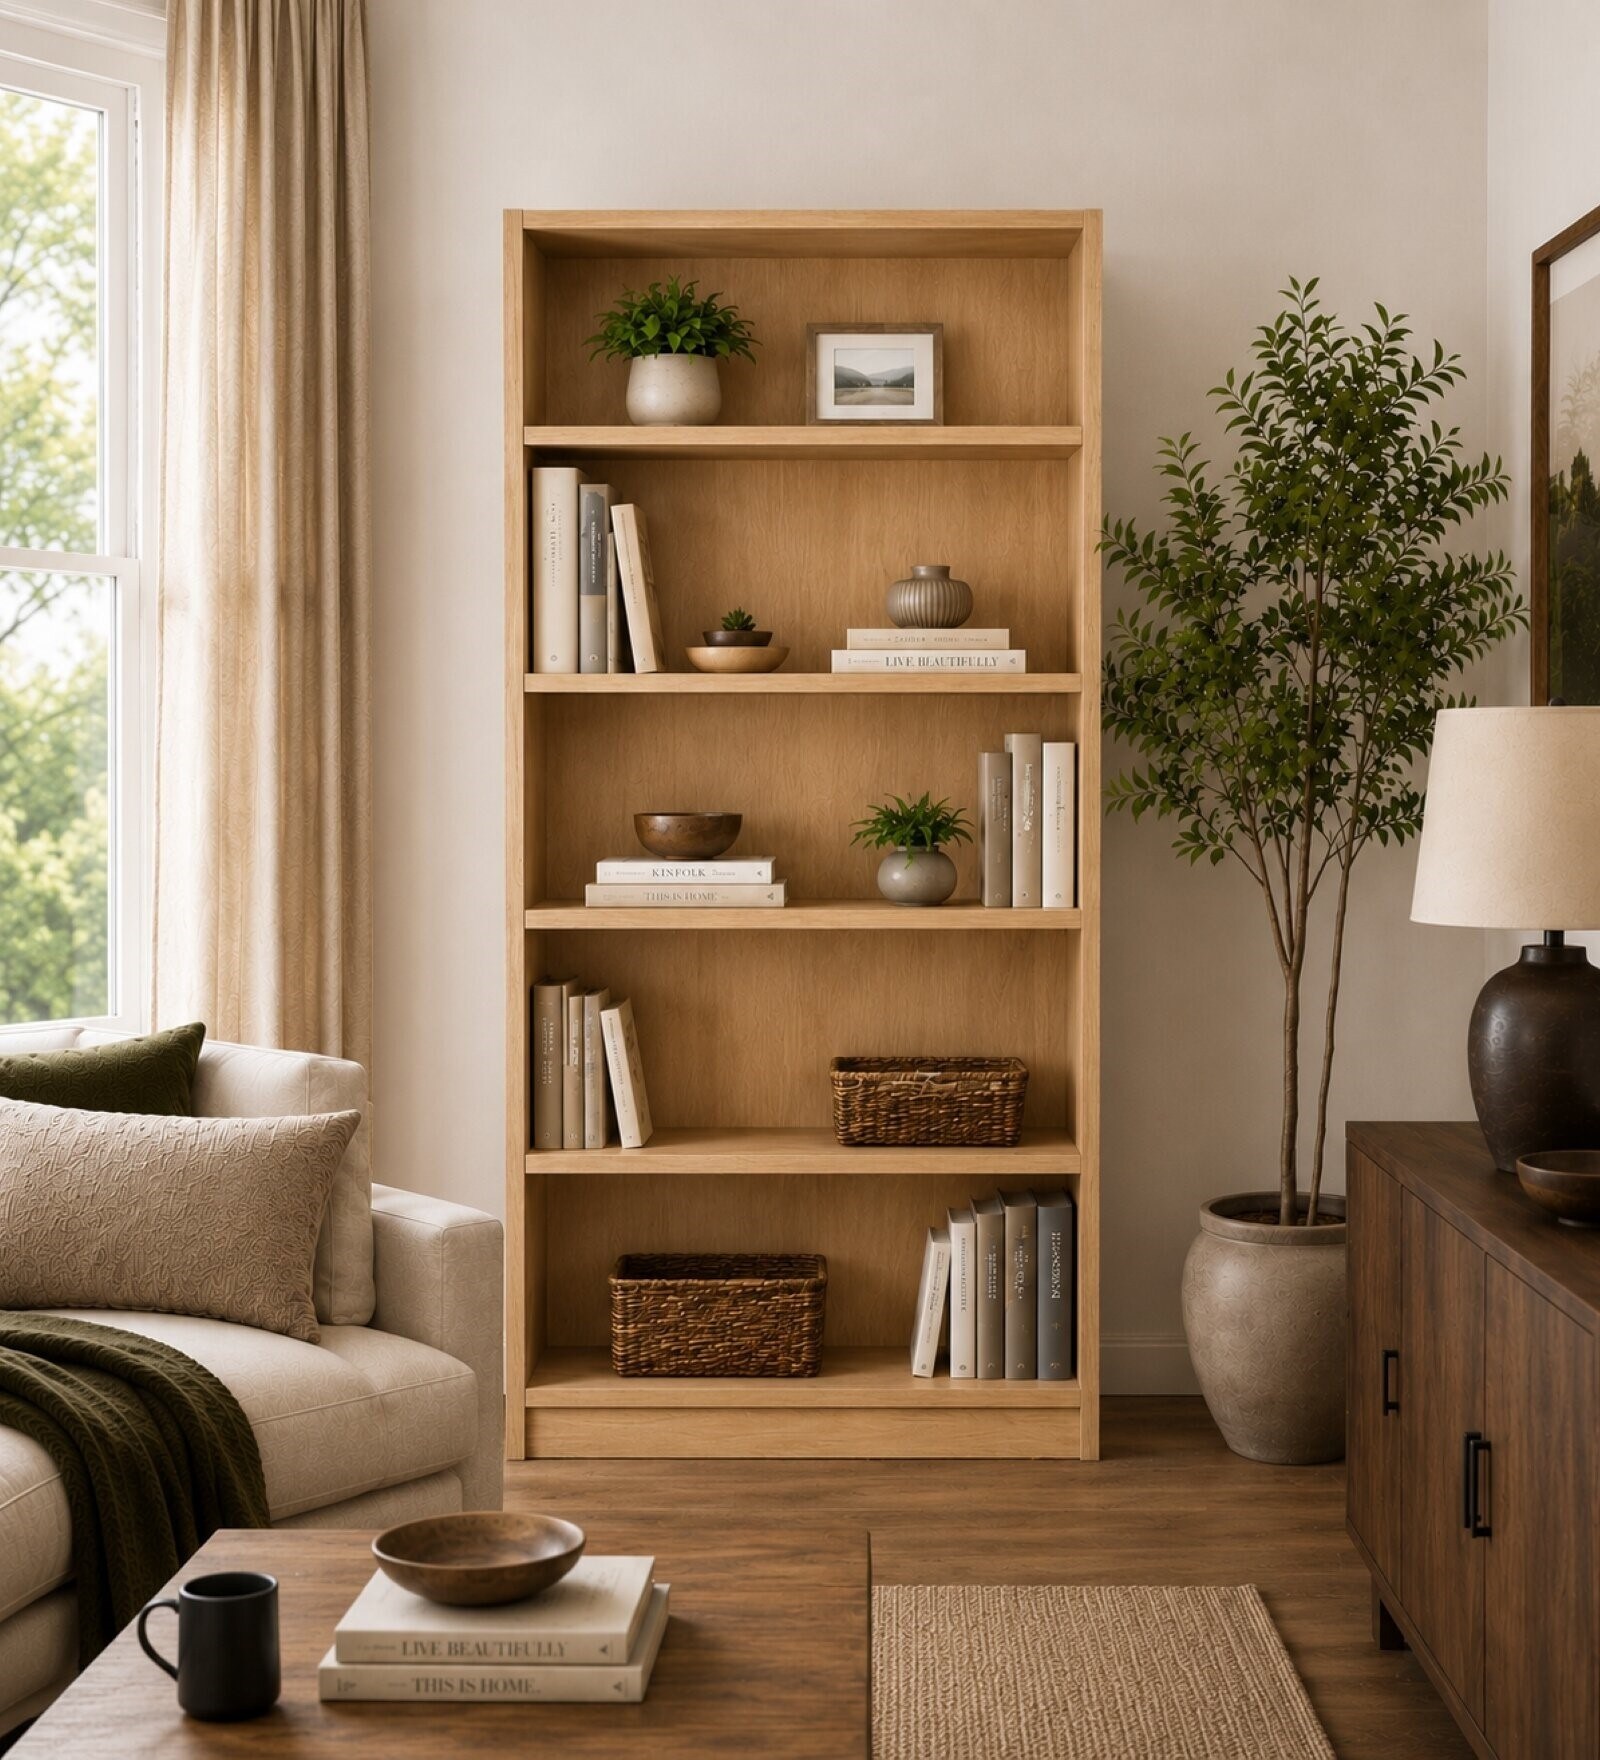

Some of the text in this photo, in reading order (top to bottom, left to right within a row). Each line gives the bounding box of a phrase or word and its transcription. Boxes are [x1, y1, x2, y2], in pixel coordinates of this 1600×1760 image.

[885, 656, 914, 667] LIVE
[918, 656, 999, 667] BEAUTIFULLY
[652, 868, 706, 878] KINFOLK
[644, 891, 669, 901] THIS
[672, 891, 683, 901] IS
[401, 1640, 442, 1657] LIVE
[447, 1640, 568, 1657] BEAUTIFULLY
[412, 1677, 454, 1694] THIS
[459, 1677, 476, 1694] IS
